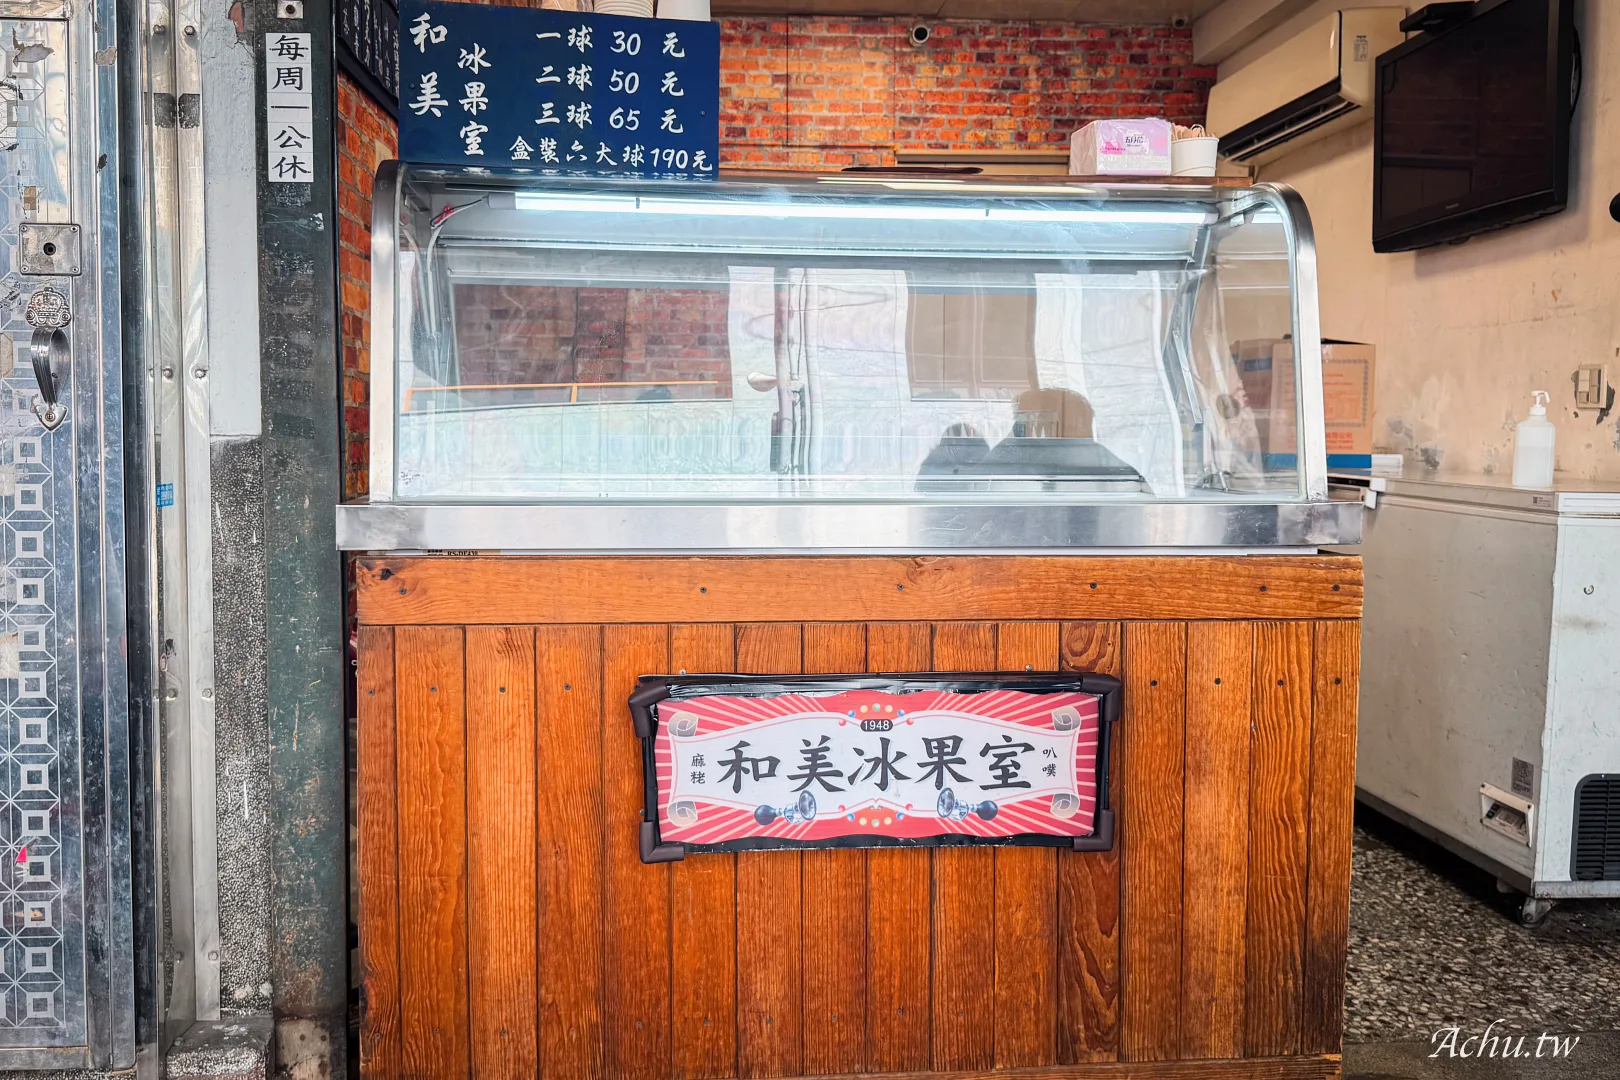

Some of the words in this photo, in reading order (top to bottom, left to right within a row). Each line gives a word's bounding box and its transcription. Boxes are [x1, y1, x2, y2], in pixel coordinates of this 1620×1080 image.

[535, 24, 593, 53] 一球
[609, 30, 642, 56] 30
[662, 31, 686, 58] 元
[409, 12, 448, 119] 和美
[535, 63, 593, 91] 二球
[608, 69, 640, 94] 50
[660, 70, 685, 97] 元
[269, 34, 311, 180] 每周一公休
[456, 43, 492, 157] 冰果室
[534, 101, 593, 129] 三球
[609, 106, 641, 131] 65
[660, 108, 684, 134] 元
[863, 719, 890, 731] 1948
[716, 734, 1036, 794] 和美冰果室
[1042, 746, 1058, 777] 叭噗
